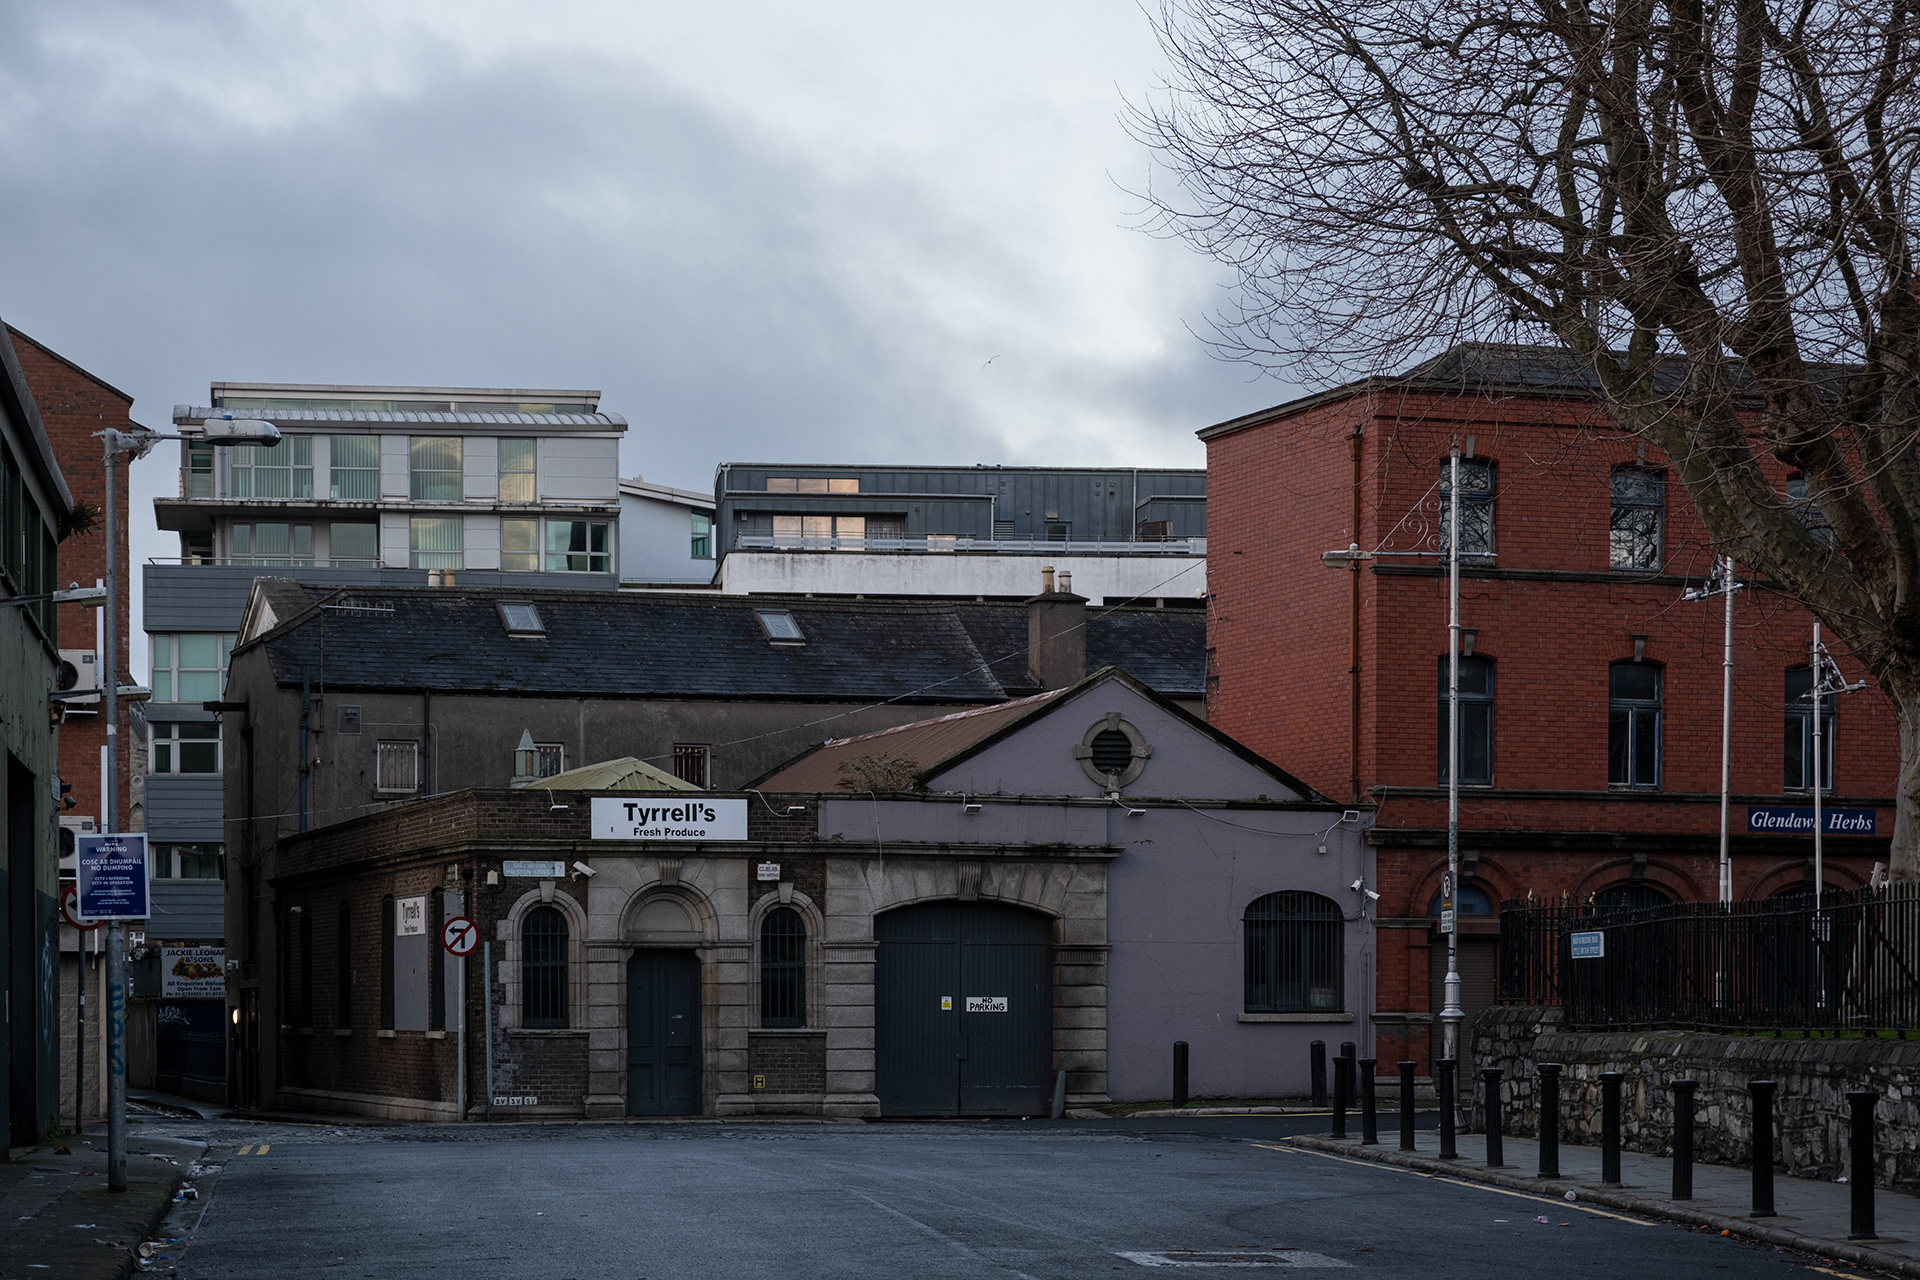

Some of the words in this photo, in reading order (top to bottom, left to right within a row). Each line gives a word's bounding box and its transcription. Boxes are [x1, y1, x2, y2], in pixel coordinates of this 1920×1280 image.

[623, 802, 716, 827] Tyrrell's
[1829, 813, 1873, 831] Herbs
[633, 827, 662, 837] Fresh
[664, 827, 706, 837] Produce
[505, 868, 532, 876] HALSTON
[533, 868, 555, 876] STREET
[166, 949, 193, 957] JACKIE
[969, 1002, 1005, 1011] PARKING
[755, 1076, 764, 1087] H
